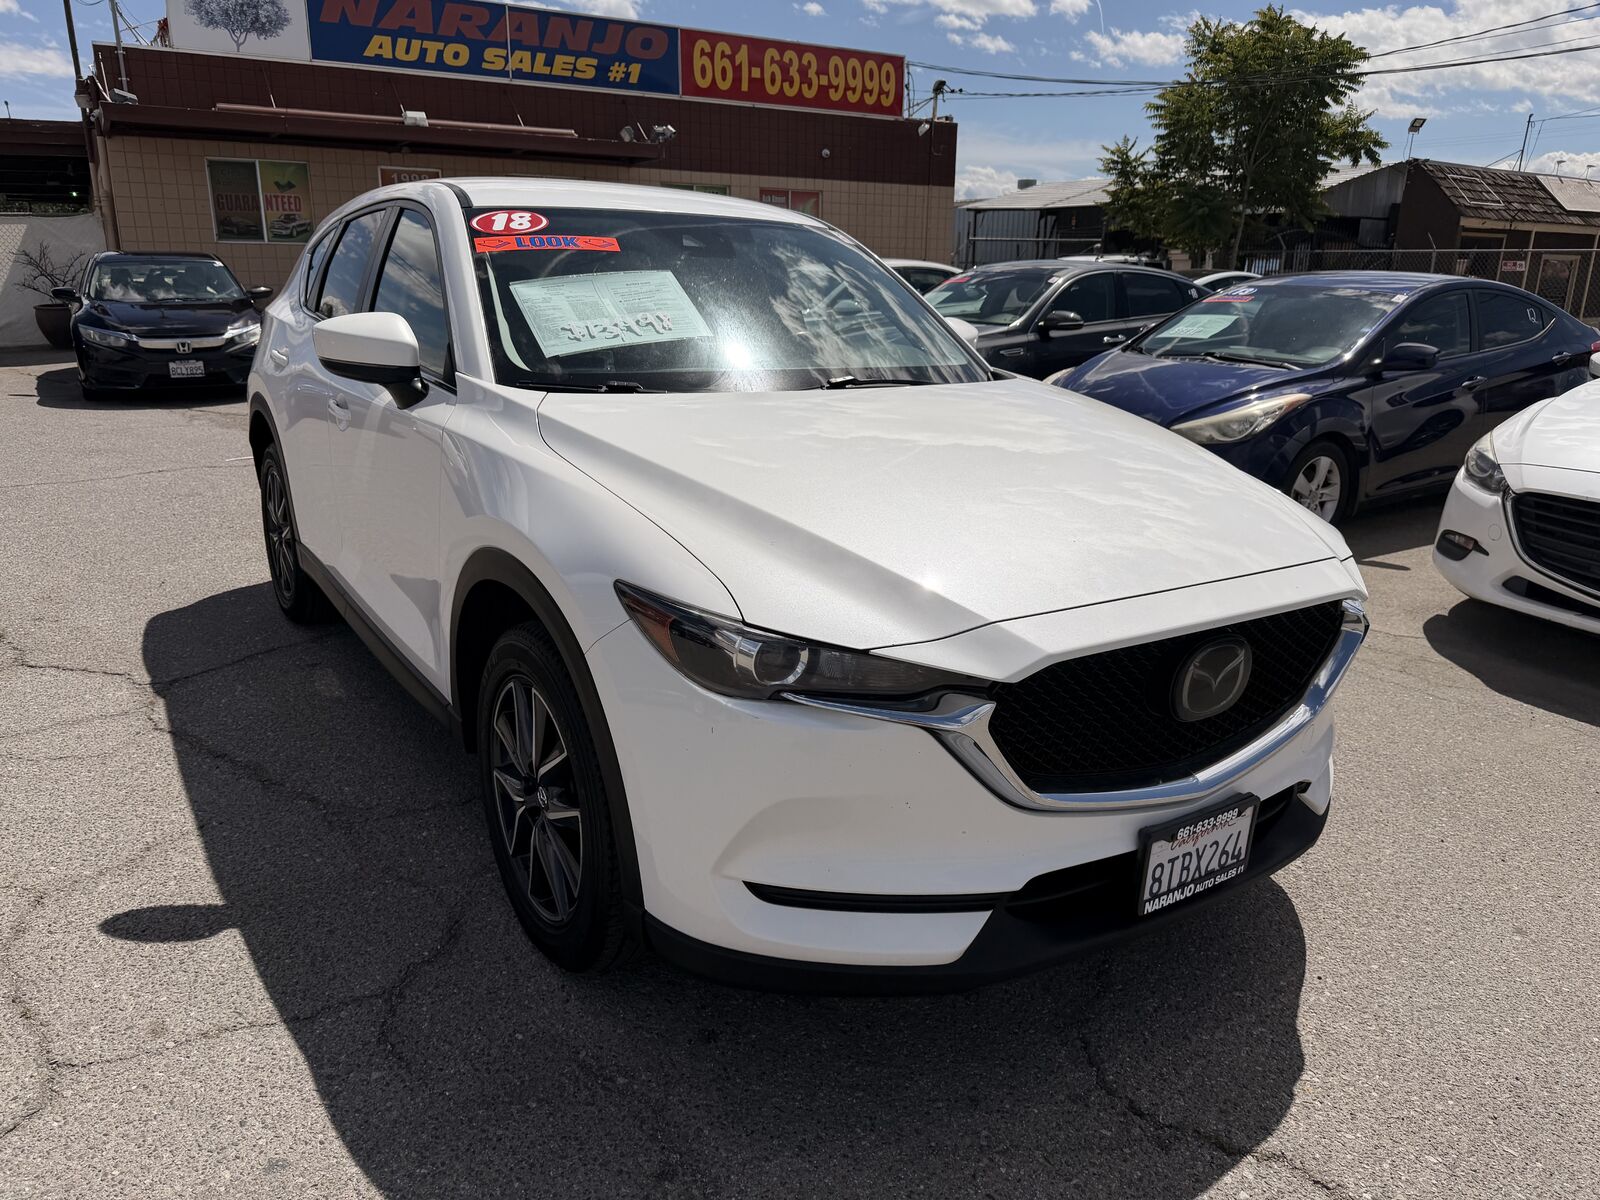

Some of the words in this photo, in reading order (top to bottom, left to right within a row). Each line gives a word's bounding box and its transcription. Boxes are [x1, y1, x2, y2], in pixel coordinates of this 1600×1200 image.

[319, 0, 669, 60] NARANJO
[363, 34, 470, 67] AUTO
[481, 47, 598, 80] SALES
[607, 61, 642, 84] #1
[693, 39, 896, 107] 661-633-9999
[215, 193, 303, 212] GUARANTEED
[491, 212, 532, 231] 18
[514, 236, 581, 249] LOOK
[1148, 830, 1242, 898] 8TBX264
[1144, 883, 1195, 915] NARANJO
[1194, 878, 1214, 894] AUTO
[1214, 867, 1237, 885] SALES
